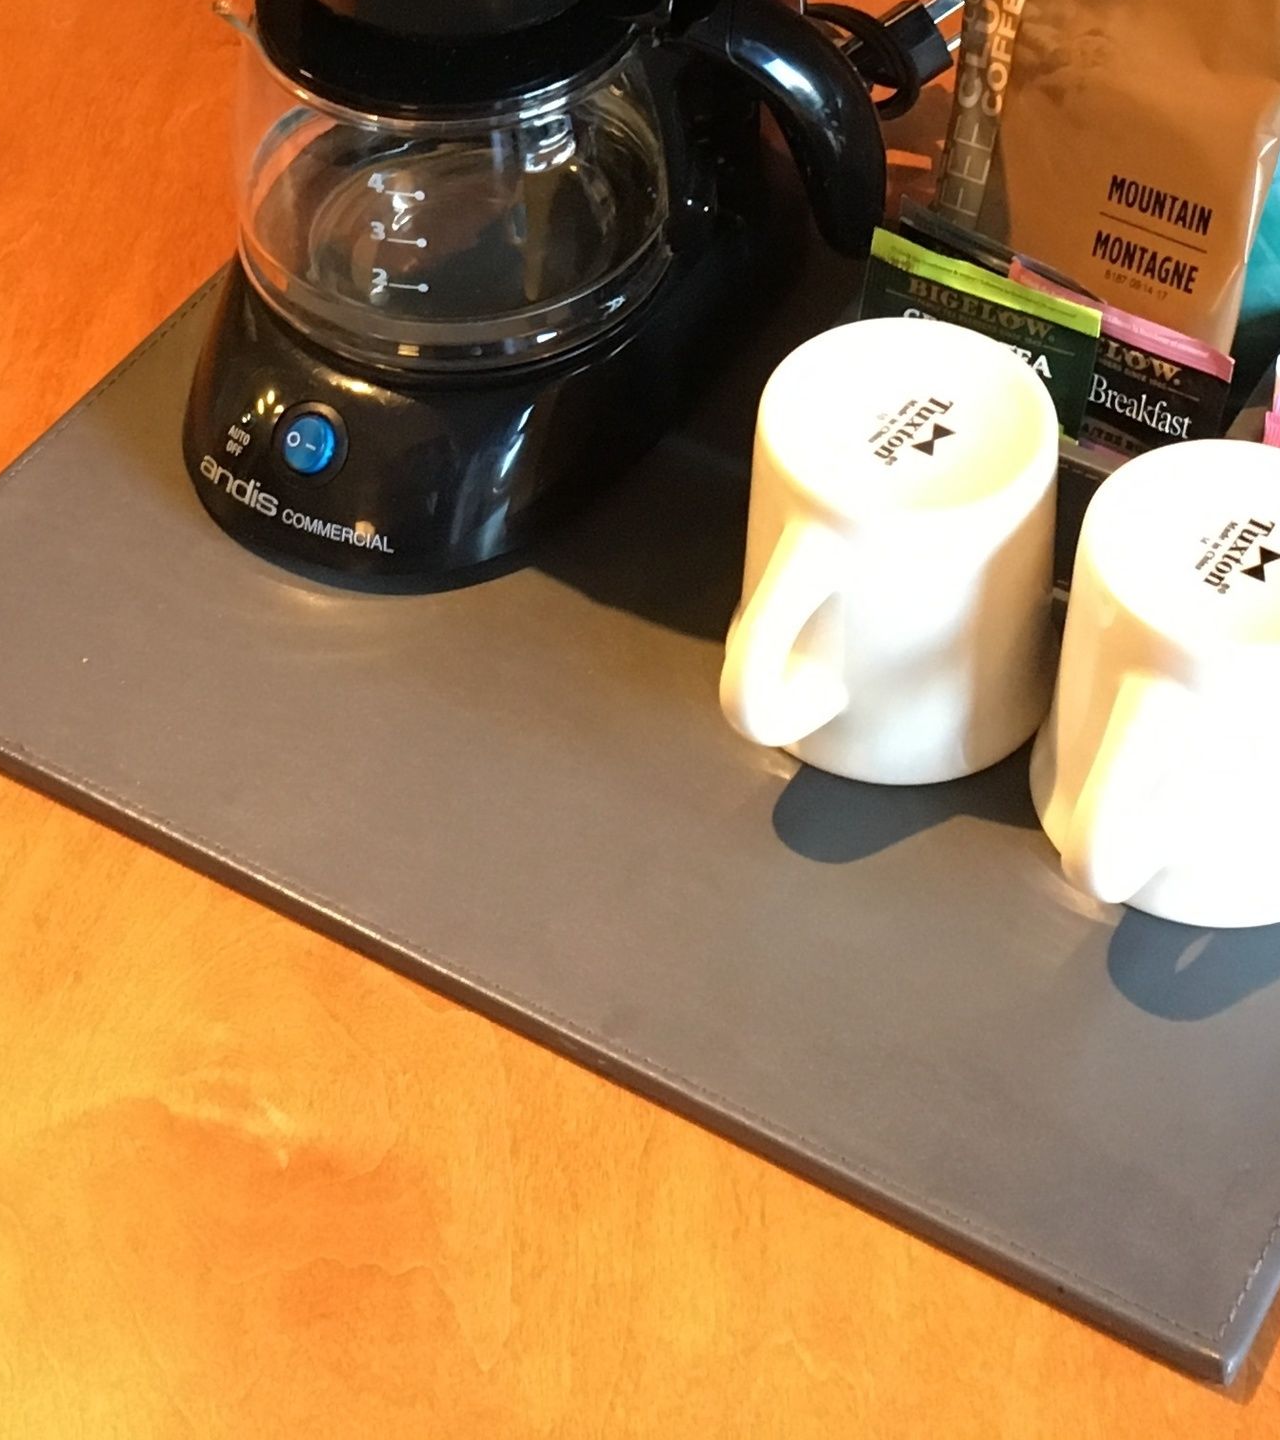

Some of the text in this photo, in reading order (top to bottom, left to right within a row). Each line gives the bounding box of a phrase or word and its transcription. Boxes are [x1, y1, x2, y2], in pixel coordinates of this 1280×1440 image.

[367, 172, 385, 193] 4
[1107, 174, 1213, 236] MOUNTAIN
[370, 221, 385, 240] 3
[372, 268, 388, 286] 2
[1091, 229, 1199, 295] MONTAGNE
[908, 277, 1054, 340] BIGELOW
[1088, 373, 1192, 440] Breakfast
[226, 440, 244, 457] OFF
[227, 424, 251, 446] AUTO
[200, 454, 395, 554] andis COMMERCIAL
